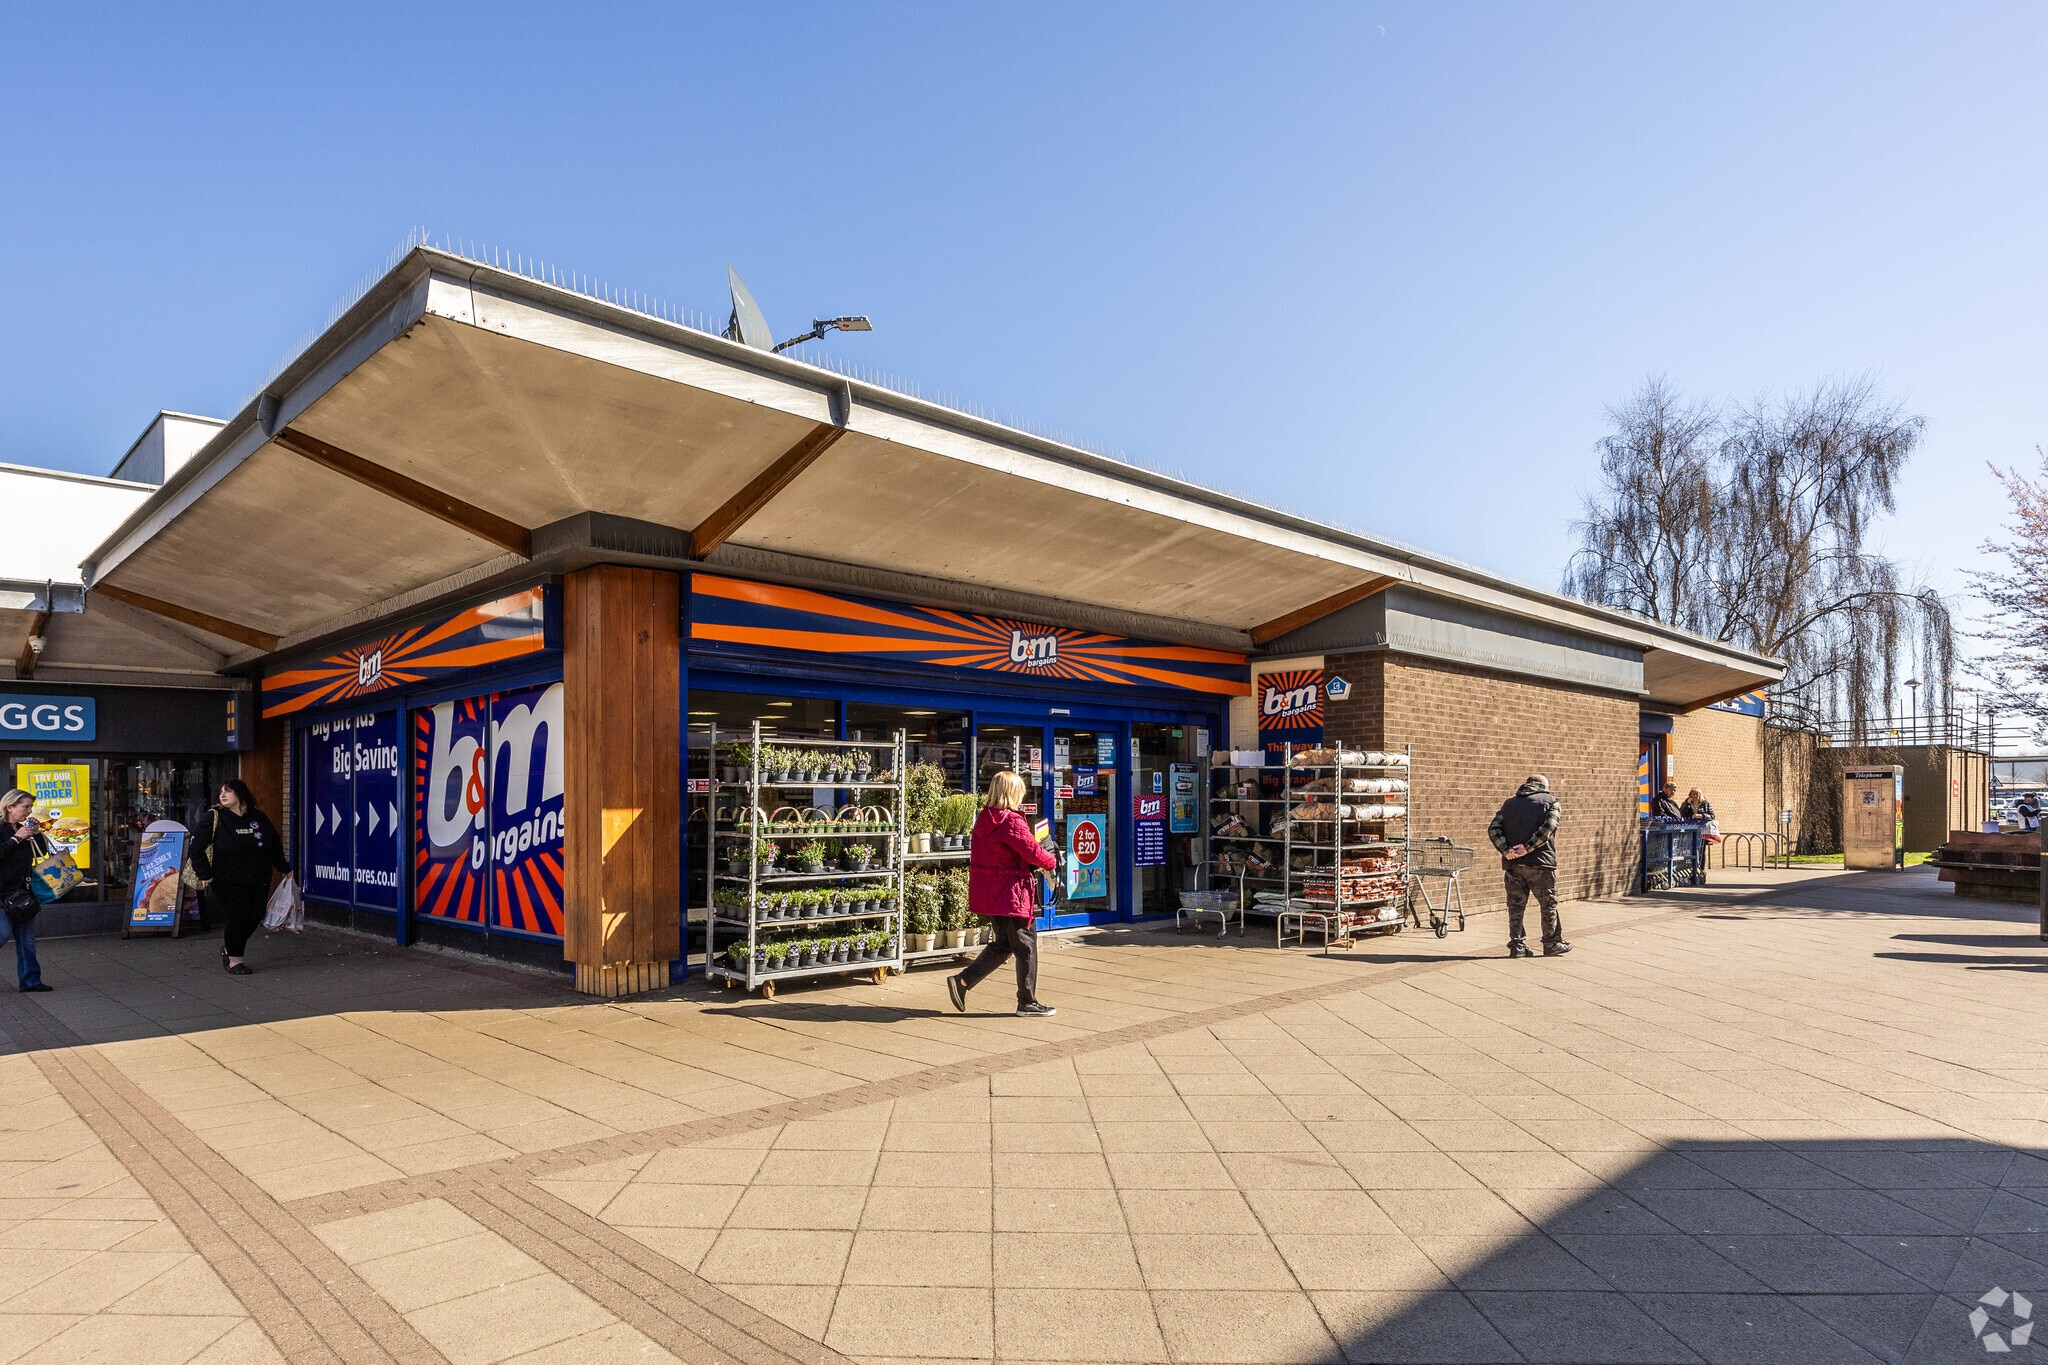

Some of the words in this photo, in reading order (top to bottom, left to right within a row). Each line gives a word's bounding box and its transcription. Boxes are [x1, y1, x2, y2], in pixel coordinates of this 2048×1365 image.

[1027, 656, 1057, 668] bargains
[1281, 703, 1317, 717] bargains
[0, 703, 84, 732] GGS
[333, 744, 350, 780] Big
[34, 773, 51, 782] TRY
[53, 772, 70, 780] OUR
[34, 781, 58, 789] MADE
[60, 780, 71, 788] TO
[36, 788, 72, 799] ORDER
[1078, 830, 1084, 840] 2
[1085, 829, 1095, 840] for
[1078, 841, 1096, 854] £20
[140, 851, 172, 873] FRESHLY
[143, 864, 165, 880] MADE
[315, 861, 398, 887] www.bmores.co.u
[1073, 868, 1100, 883] TOYS
